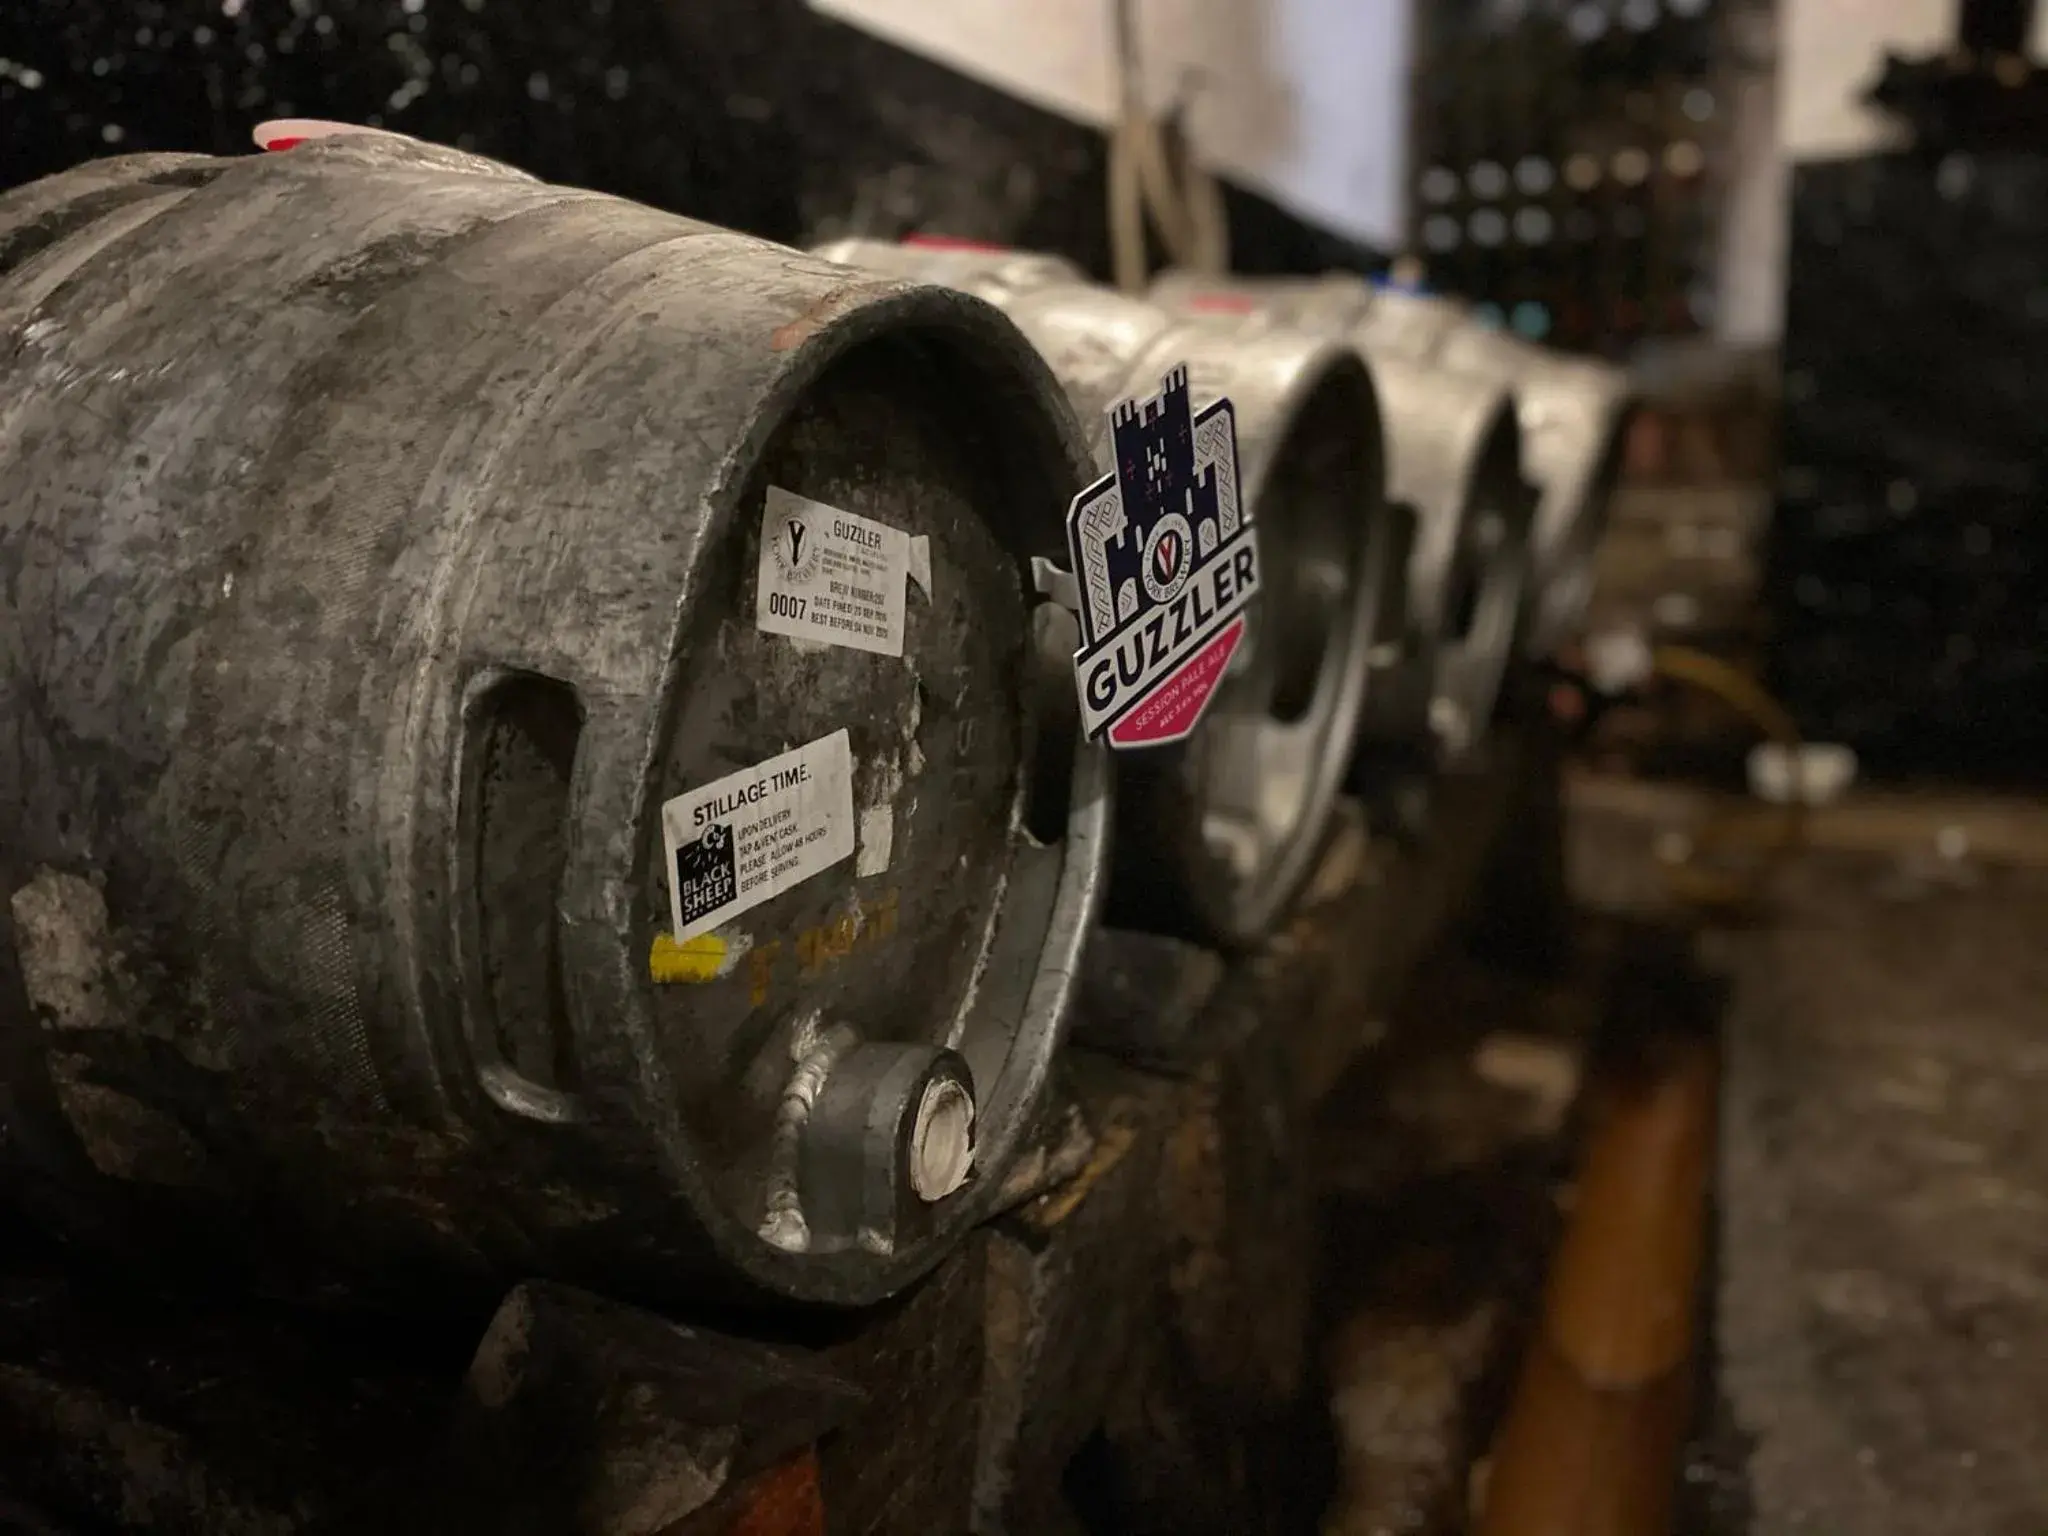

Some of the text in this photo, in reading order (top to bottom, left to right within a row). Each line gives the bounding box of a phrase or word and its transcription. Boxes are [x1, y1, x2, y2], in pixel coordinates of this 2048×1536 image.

[834, 520, 882, 550] GUZZLER
[1145, 569, 1162, 599] YORK
[769, 592, 807, 620] 0007
[811, 611, 828, 626] BEST
[814, 595, 831, 610] DATE
[1085, 544, 1257, 714] GUZZLER
[1135, 643, 1226, 732] SESSION PALE ALE
[693, 763, 813, 827] STILLAGE TIME.
[738, 808, 792, 841] UPON DELIVERY
[738, 824, 798, 857] TAP & VENT CASK
[739, 827, 828, 875] PLEASE ALLOW 48 HOURS
[683, 860, 731, 897] BLACK
[684, 877, 732, 913] SHEEP
[740, 870, 768, 893] BEFORE
